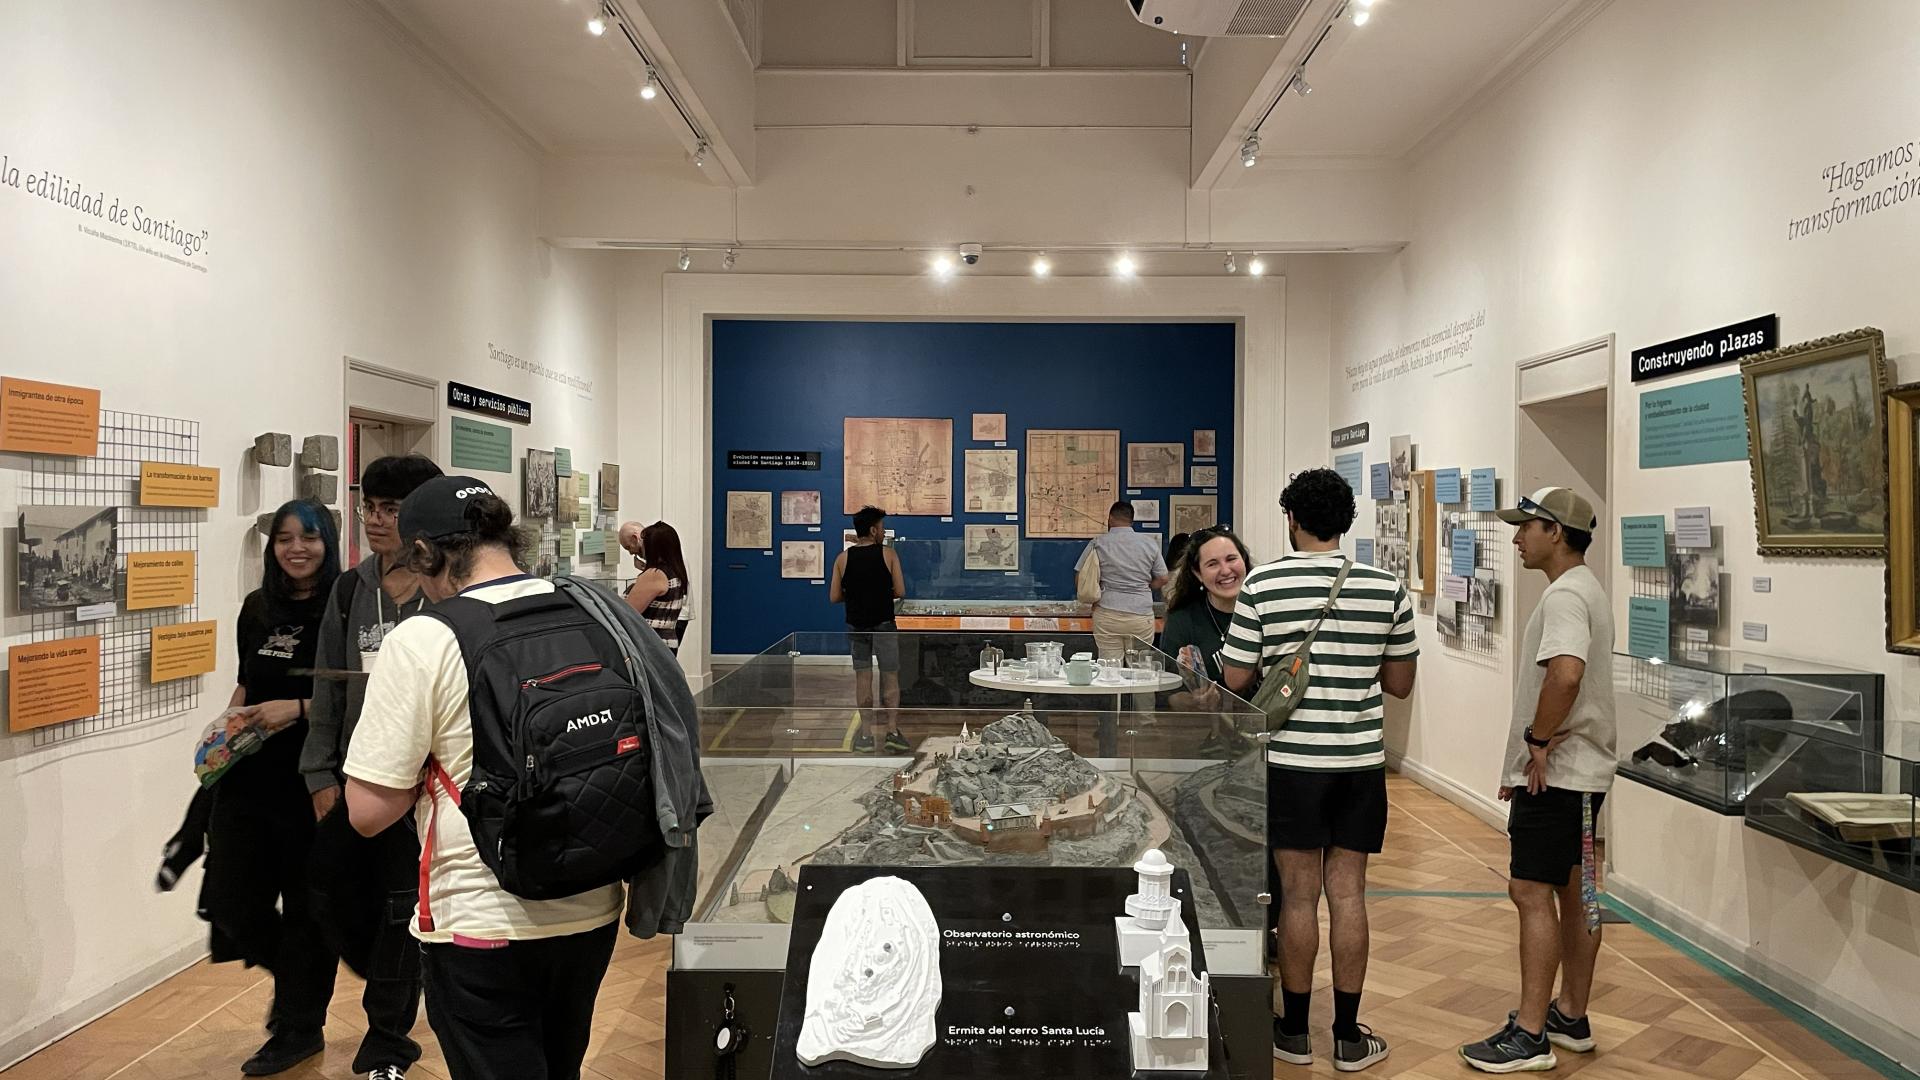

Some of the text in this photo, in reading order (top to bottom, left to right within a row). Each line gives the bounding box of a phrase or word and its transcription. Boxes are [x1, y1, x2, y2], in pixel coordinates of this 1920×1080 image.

[1822, 142, 1913, 193] “Hagamos
[1, 156, 208, 256] la edilidad de Santiago”.
[1639, 330, 1764, 373] Construyendo plazas
[46, 393, 53, 401] de
[452, 388, 529, 418] Obras y servicios públicos
[1350, 427, 1366, 439] Santiago
[133, 560, 164, 569] Mejoramiento
[17, 647, 87, 664] Mejorando la vida urbana
[566, 713, 600, 733] AMD
[943, 929, 1080, 939] Observatorio astronómico
[948, 1025, 1105, 1036] Ermita del cerro Santa Lucía
